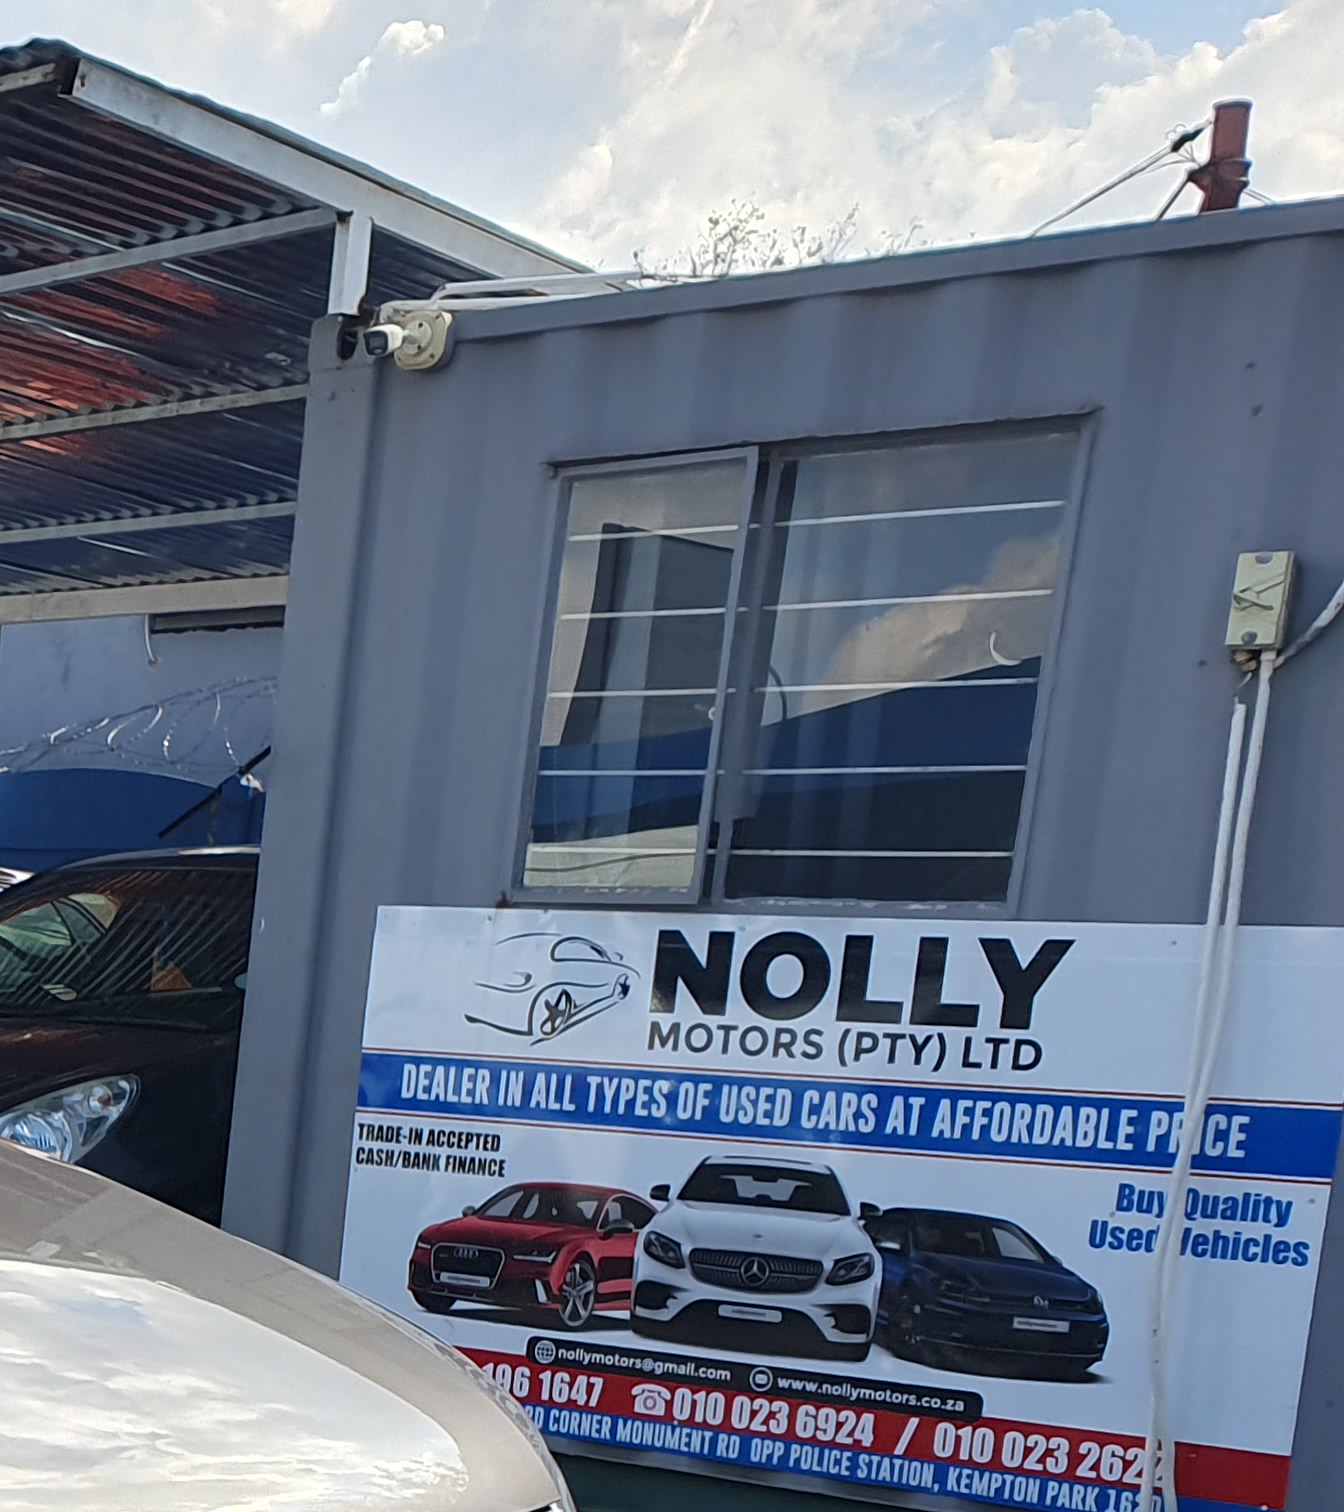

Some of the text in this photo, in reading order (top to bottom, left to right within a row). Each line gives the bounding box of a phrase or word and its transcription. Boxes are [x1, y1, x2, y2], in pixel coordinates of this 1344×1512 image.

[649, 929, 1078, 1030] NOLLY
[647, 1021, 1043, 1073] MOTORS (PTY) LTD
[357, 1122, 502, 1153] TRADE-IN ACCEPTED
[401, 1062, 490, 1107] DEALER
[497, 1068, 525, 1107] IN
[529, 1073, 577, 1112] ALL
[586, 1075, 669, 1118] TYPES
[676, 1081, 712, 1121] OF
[718, 1084, 792, 1128] USED
[800, 1088, 878, 1135] CARS
[884, 1094, 926, 1137] AT
[930, 1096, 1138, 1151] AFFORDABLE
[355, 1146, 507, 1178] CASH/BANK FINANCE
[1115, 1182, 1294, 1228] Buy Quality
[558, 1347, 965, 1412] nollymotors@gmail.com www.nollymotors.co.za
[538, 1370, 604, 1408] 1647
[672, 1387, 726, 1426] 010
[730, 1394, 790, 1435] 023
[795, 1404, 875, 1448] 6924
[933, 1421, 996, 1464] 010
[1001, 1430, 1070, 1475] 023
[548, 1408, 612, 1440] CORNER
[615, 1418, 714, 1455] MONUMENT
[716, 1433, 741, 1460] RD
[750, 1438, 785, 1466] OPP
[789, 1443, 851, 1476] POLICE
[857, 1453, 941, 1493] STATION,
[946, 1465, 1041, 1505] KEMPTON
[1045, 1483, 1101, 1512] PARK
